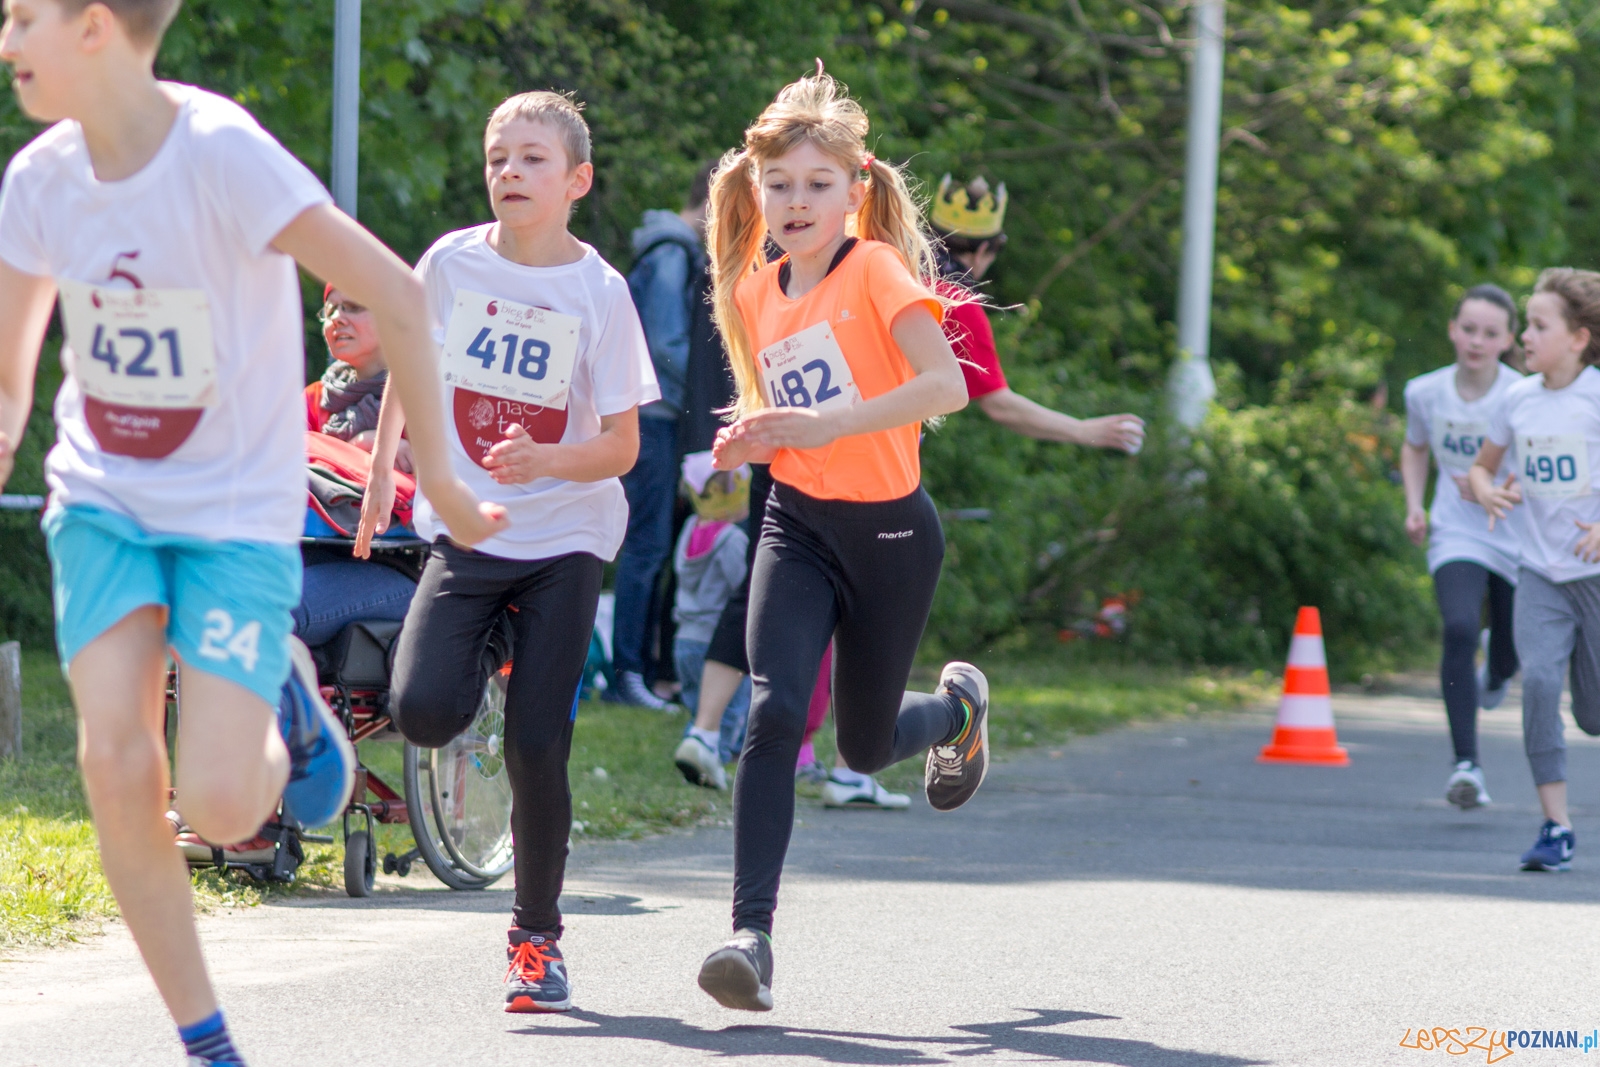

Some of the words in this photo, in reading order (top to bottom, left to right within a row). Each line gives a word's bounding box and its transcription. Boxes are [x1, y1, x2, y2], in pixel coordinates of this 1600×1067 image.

[90, 323, 184, 377] 421
[466, 326, 551, 381] 418
[770, 358, 842, 409] 482
[1525, 454, 1577, 483] 490
[877, 529, 914, 539] martes
[197, 607, 262, 674] 24
